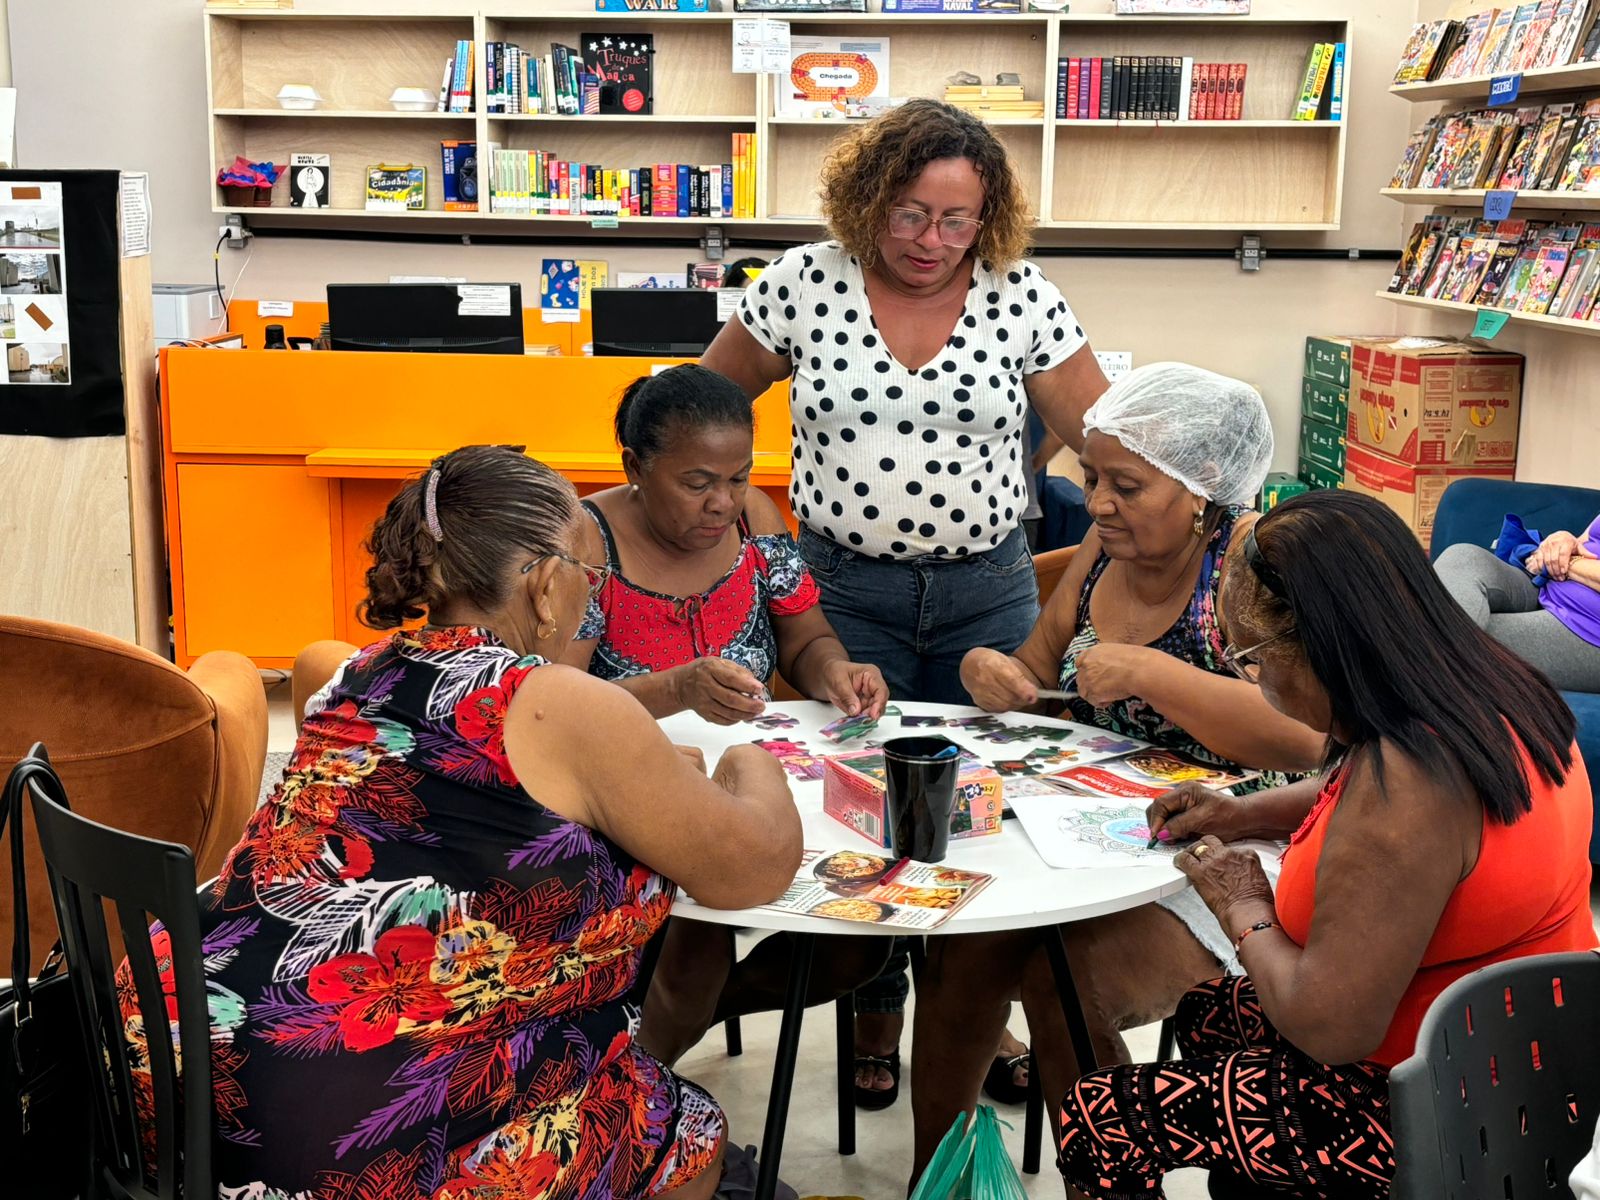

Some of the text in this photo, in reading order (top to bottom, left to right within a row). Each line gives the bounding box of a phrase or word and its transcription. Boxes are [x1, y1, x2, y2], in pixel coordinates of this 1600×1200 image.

[943, 2, 973, 11] NAVAL
[597, 48, 647, 68] Truques
[587, 61, 636, 81] Mágca
